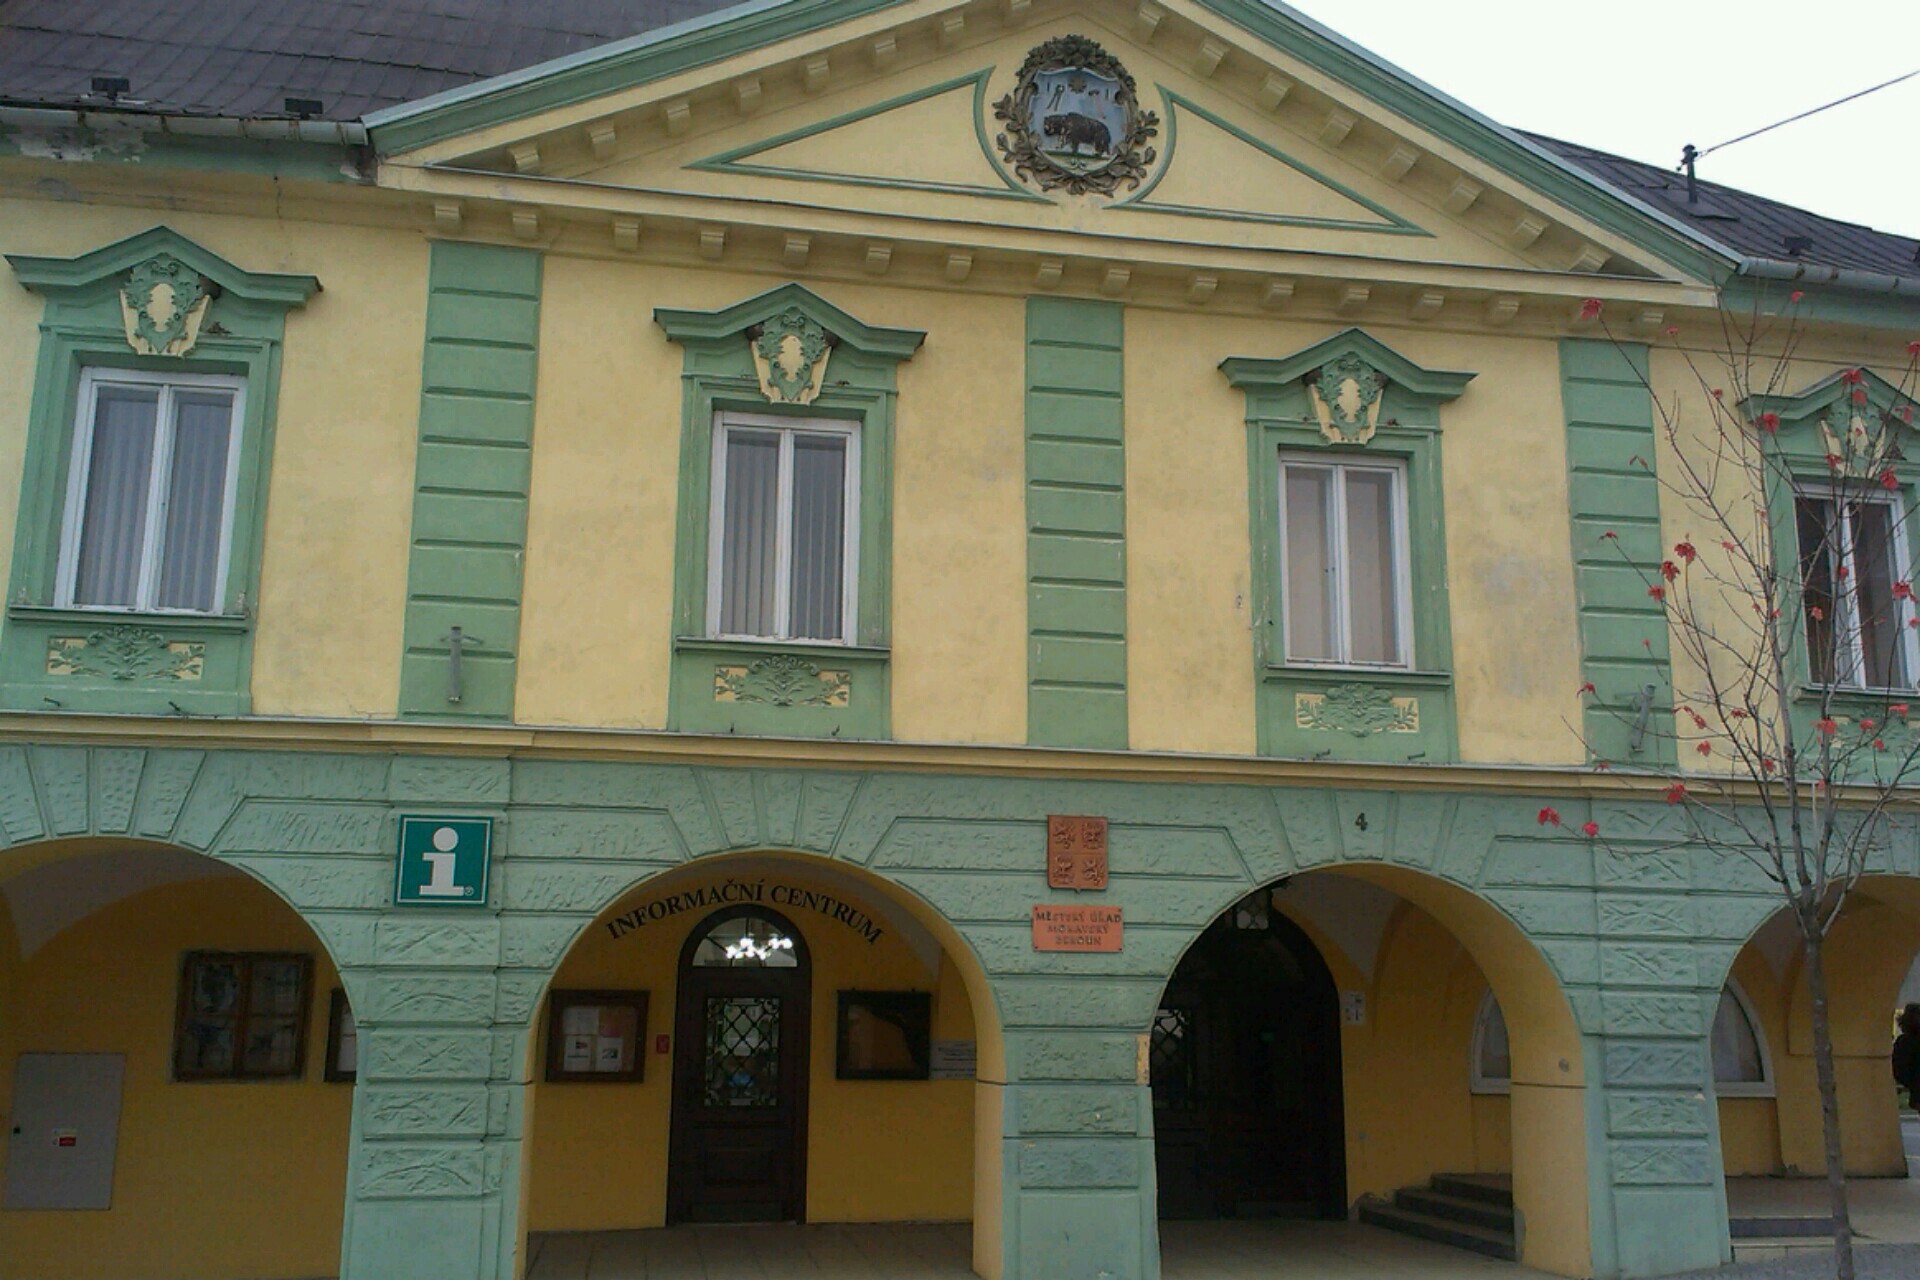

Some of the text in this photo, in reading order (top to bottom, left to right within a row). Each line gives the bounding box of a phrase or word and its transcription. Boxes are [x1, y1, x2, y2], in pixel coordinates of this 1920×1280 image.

[1355, 812, 1368, 831] 4
[606, 879, 883, 944] INFORMAČNÍ CENTRUM
